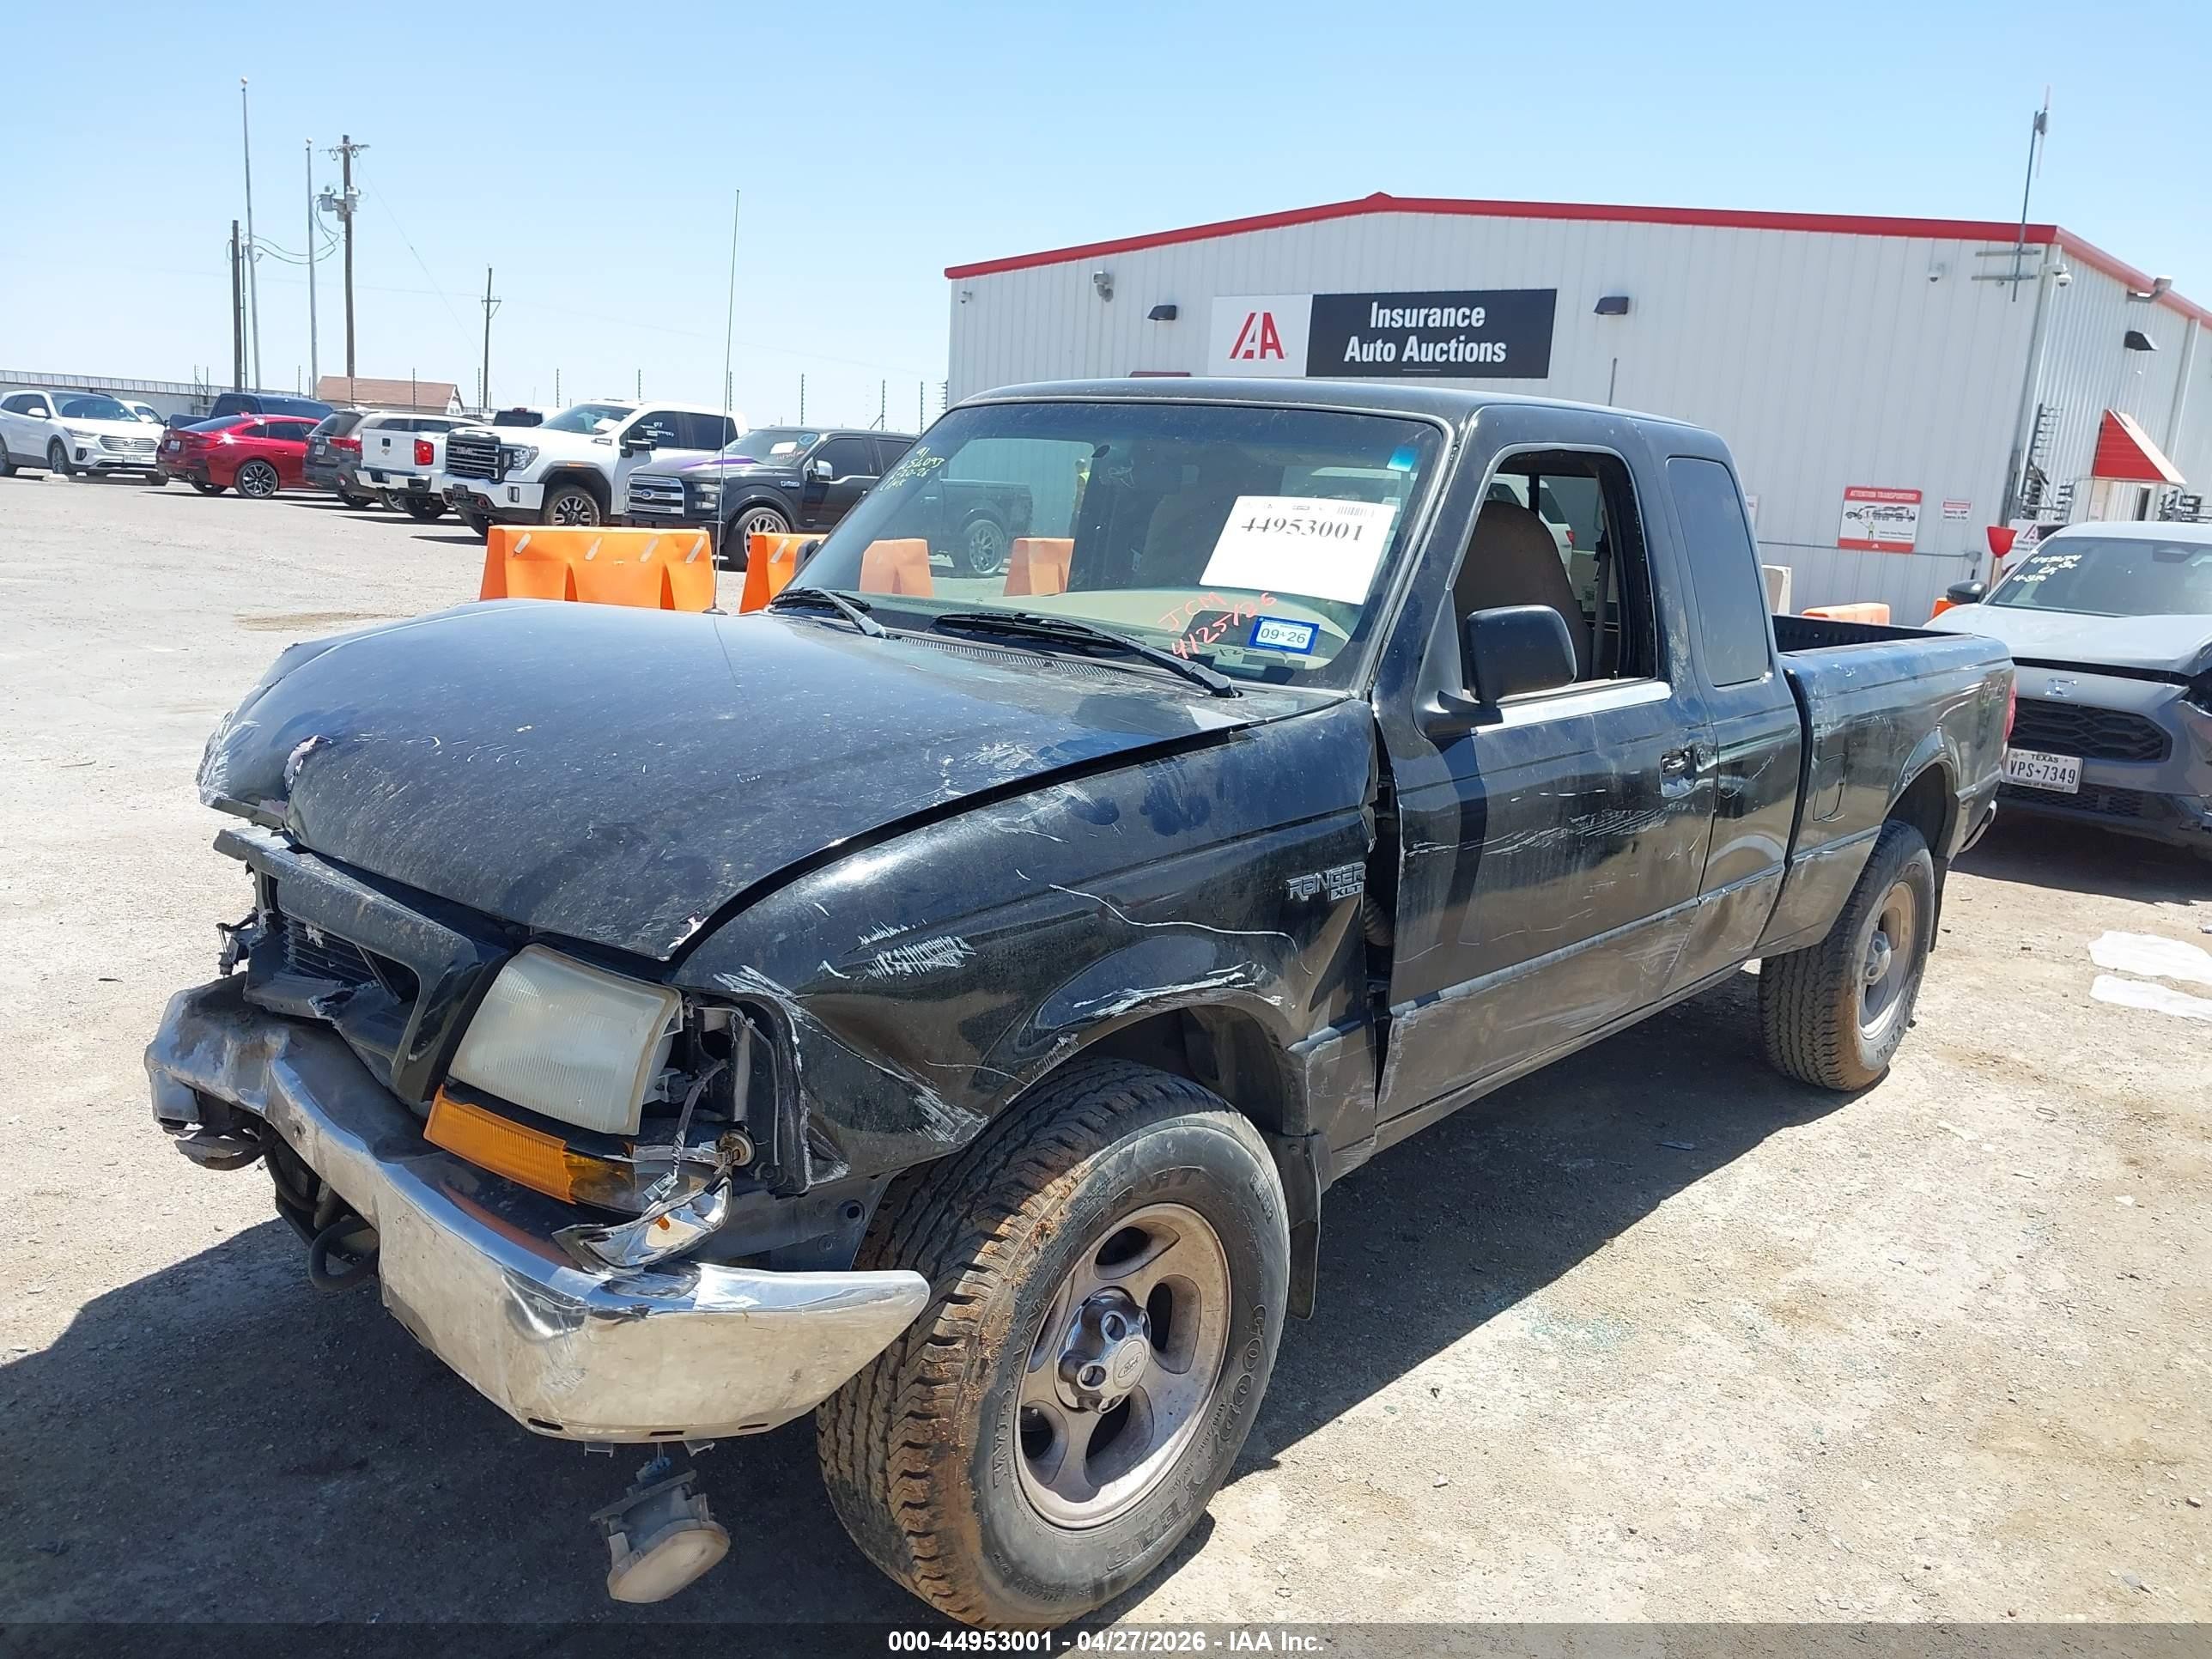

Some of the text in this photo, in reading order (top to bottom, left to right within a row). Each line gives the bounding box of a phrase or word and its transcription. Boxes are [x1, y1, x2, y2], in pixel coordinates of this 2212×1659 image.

[1370, 301, 1486, 329] Insurance
[1343, 335, 1507, 364] Auto Auctions
[1241, 517, 1364, 541] 44953001
[2031, 753, 2059, 763] TEXAS
[1285, 861, 1366, 901] RANGER
